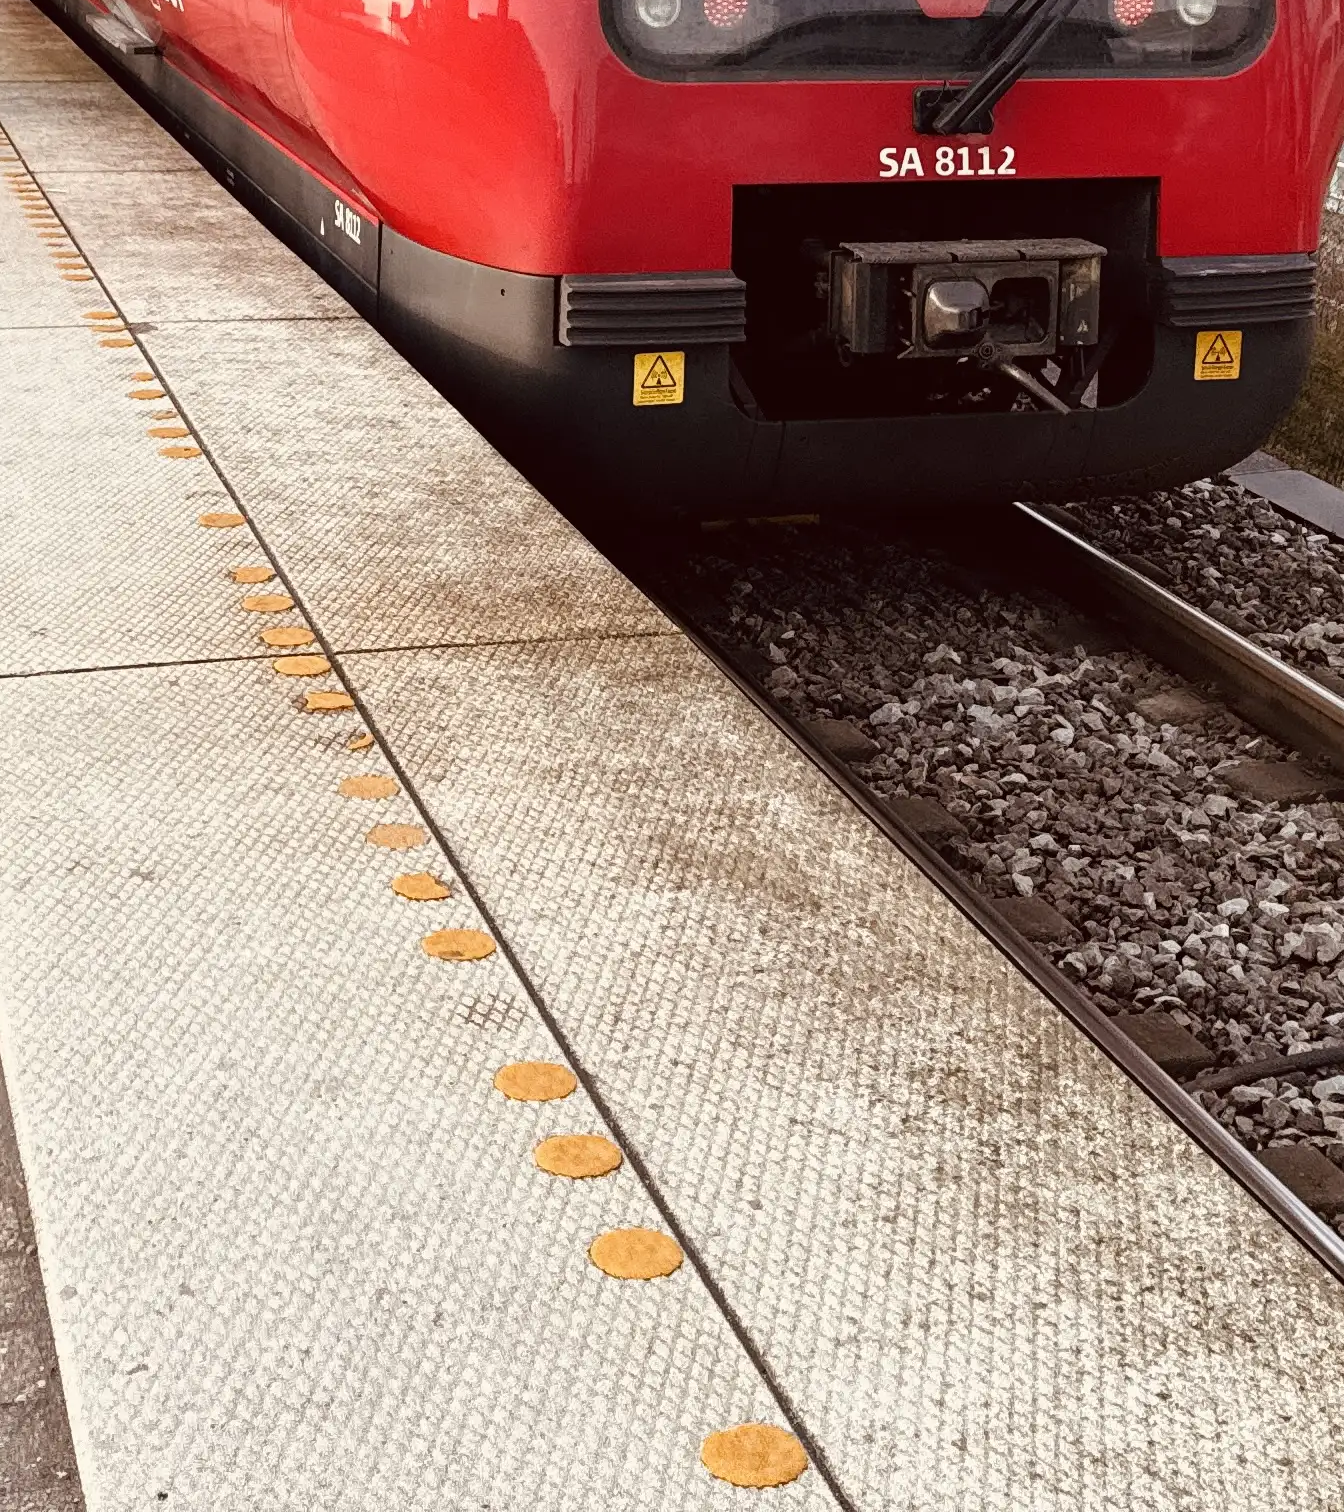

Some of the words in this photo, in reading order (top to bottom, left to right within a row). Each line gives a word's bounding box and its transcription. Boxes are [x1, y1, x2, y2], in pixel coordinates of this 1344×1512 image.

[879, 147, 925, 178] SA
[934, 145, 1017, 177] 8112
[334, 199, 345, 232] SA
